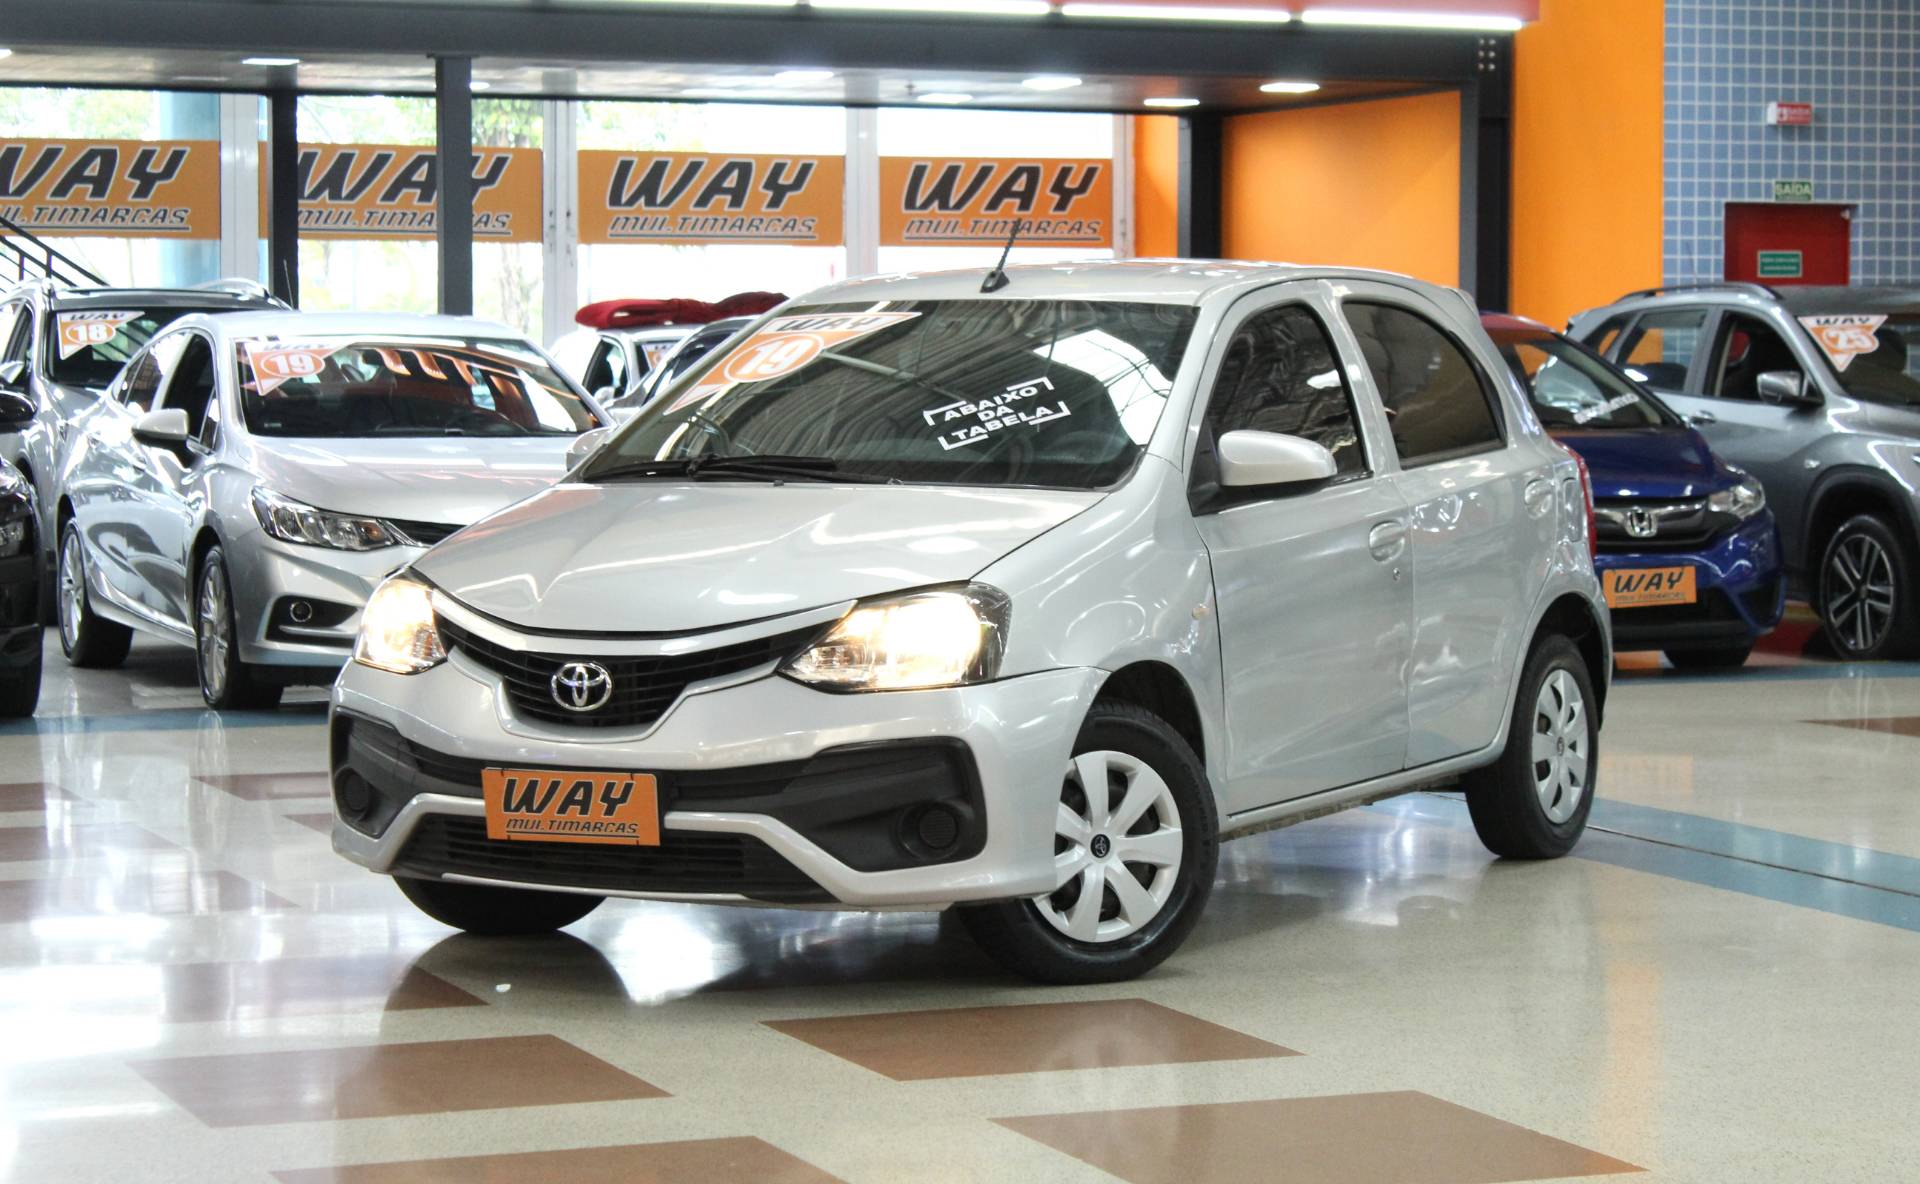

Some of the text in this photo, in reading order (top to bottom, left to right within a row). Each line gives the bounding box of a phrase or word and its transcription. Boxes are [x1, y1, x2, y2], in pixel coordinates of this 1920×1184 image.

[607, 157, 817, 211] WAY
[903, 162, 1102, 214] WAY
[609, 215, 817, 233] MULTIMARCAS
[904, 219, 1102, 235] MULTIMARCAS
[72, 324, 108, 342] 18
[780, 317, 880, 331] WAY
[267, 353, 316, 375] 19
[736, 338, 813, 376] 19
[944, 386, 1039, 422] ABAIXO
[977, 405, 1015, 422] DA
[951, 406, 1054, 440] TABELA
[1614, 571, 1684, 594] WAY
[503, 777, 636, 817] WAY
[505, 818, 639, 834] MULTIMARCAS
